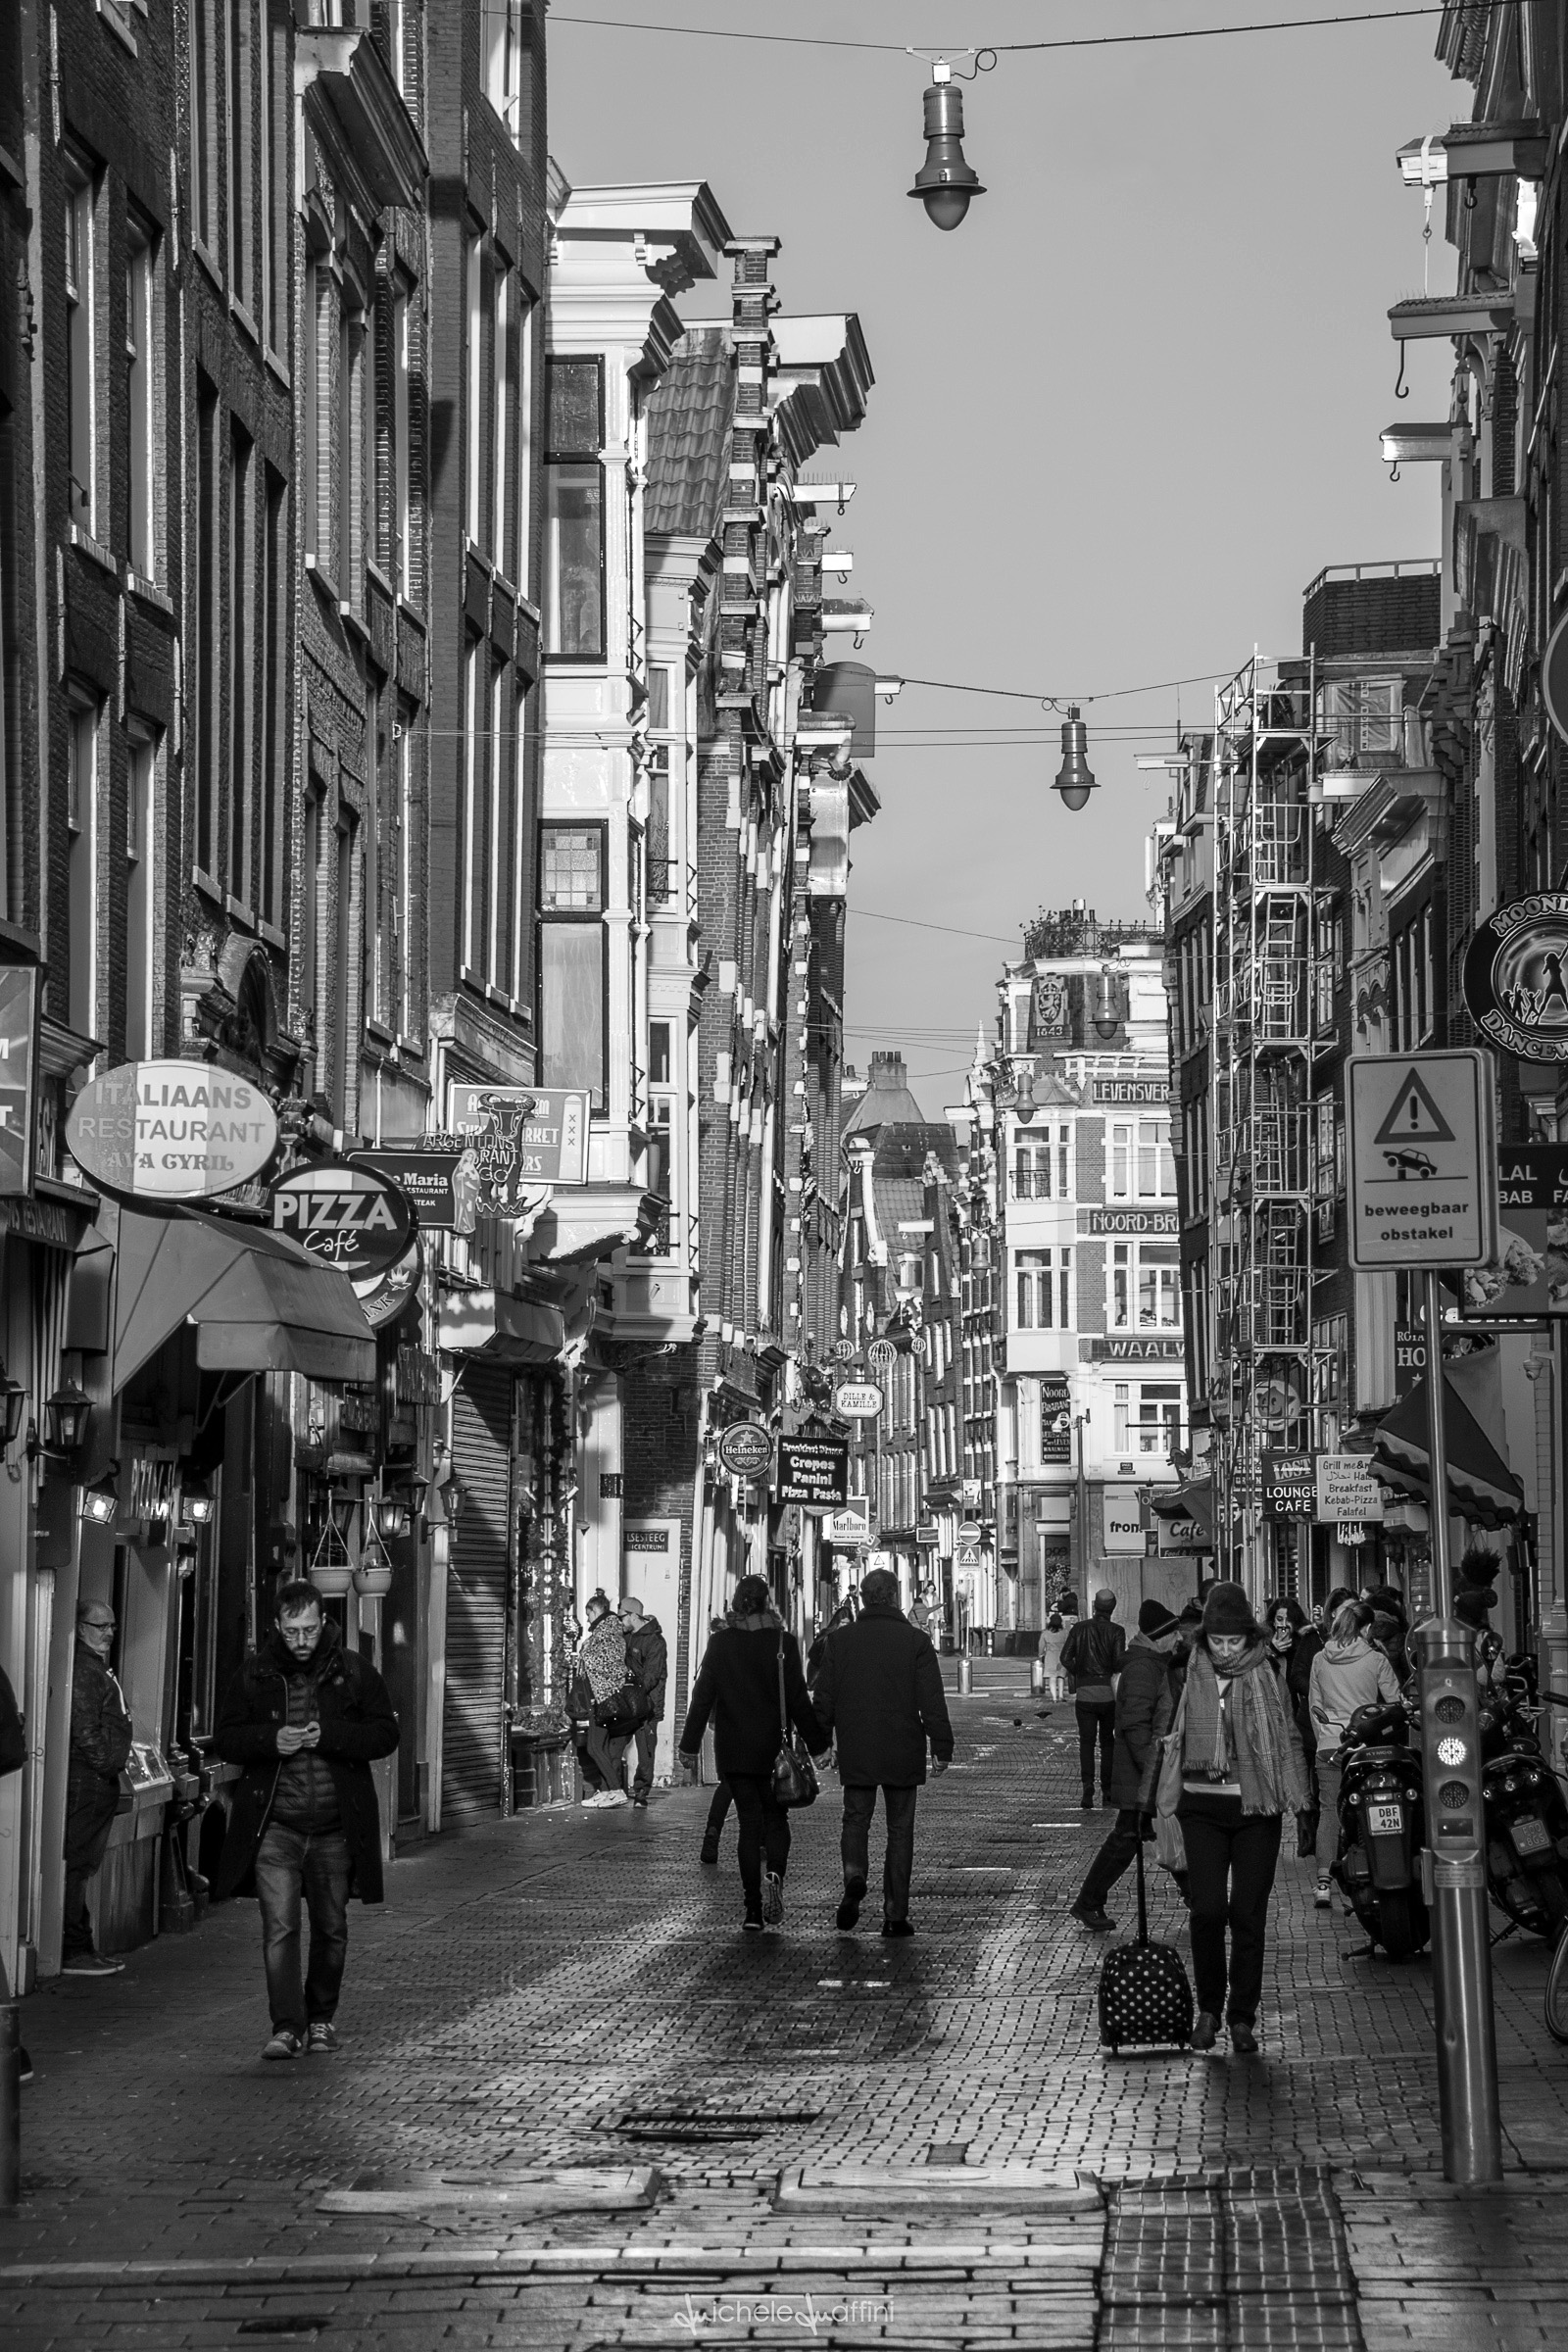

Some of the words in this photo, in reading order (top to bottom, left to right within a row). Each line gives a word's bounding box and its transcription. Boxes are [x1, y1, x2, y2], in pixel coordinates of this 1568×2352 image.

[95, 1082, 252, 1110] ITALIAANS
[1093, 1083, 1170, 1102] LEVENSVER
[77, 1116, 267, 1144] RESTAURANT
[161, 1152, 234, 1171] CYRIL
[403, 1172, 449, 1187] Maria
[273, 1194, 398, 1231] PIZZA
[1364, 1201, 1469, 1218] beweegbaar
[1380, 1226, 1454, 1241] obstakel
[303, 1229, 360, 1261] Café
[841, 1399, 877, 1408] KAMILLE
[725, 1446, 768, 1454] Heineken
[790, 1455, 836, 1471] Crepes
[1323, 1461, 1341, 1470] Grill
[792, 1471, 833, 1486] Panini
[781, 1486, 808, 1498] Pizza
[812, 1488, 842, 1501] Pasta
[1329, 1483, 1373, 1493] Breakfast
[1275, 1499, 1311, 1511] CAFE
[1324, 1495, 1378, 1504] Kebab-Pizza
[1337, 1506, 1367, 1516] Falafel
[833, 1517, 866, 1531] Marlboro
[1378, 1807, 1398, 1818] DBF
[1380, 1818, 1400, 1829] 42N
[1526, 1833, 1545, 1846] 8GS
